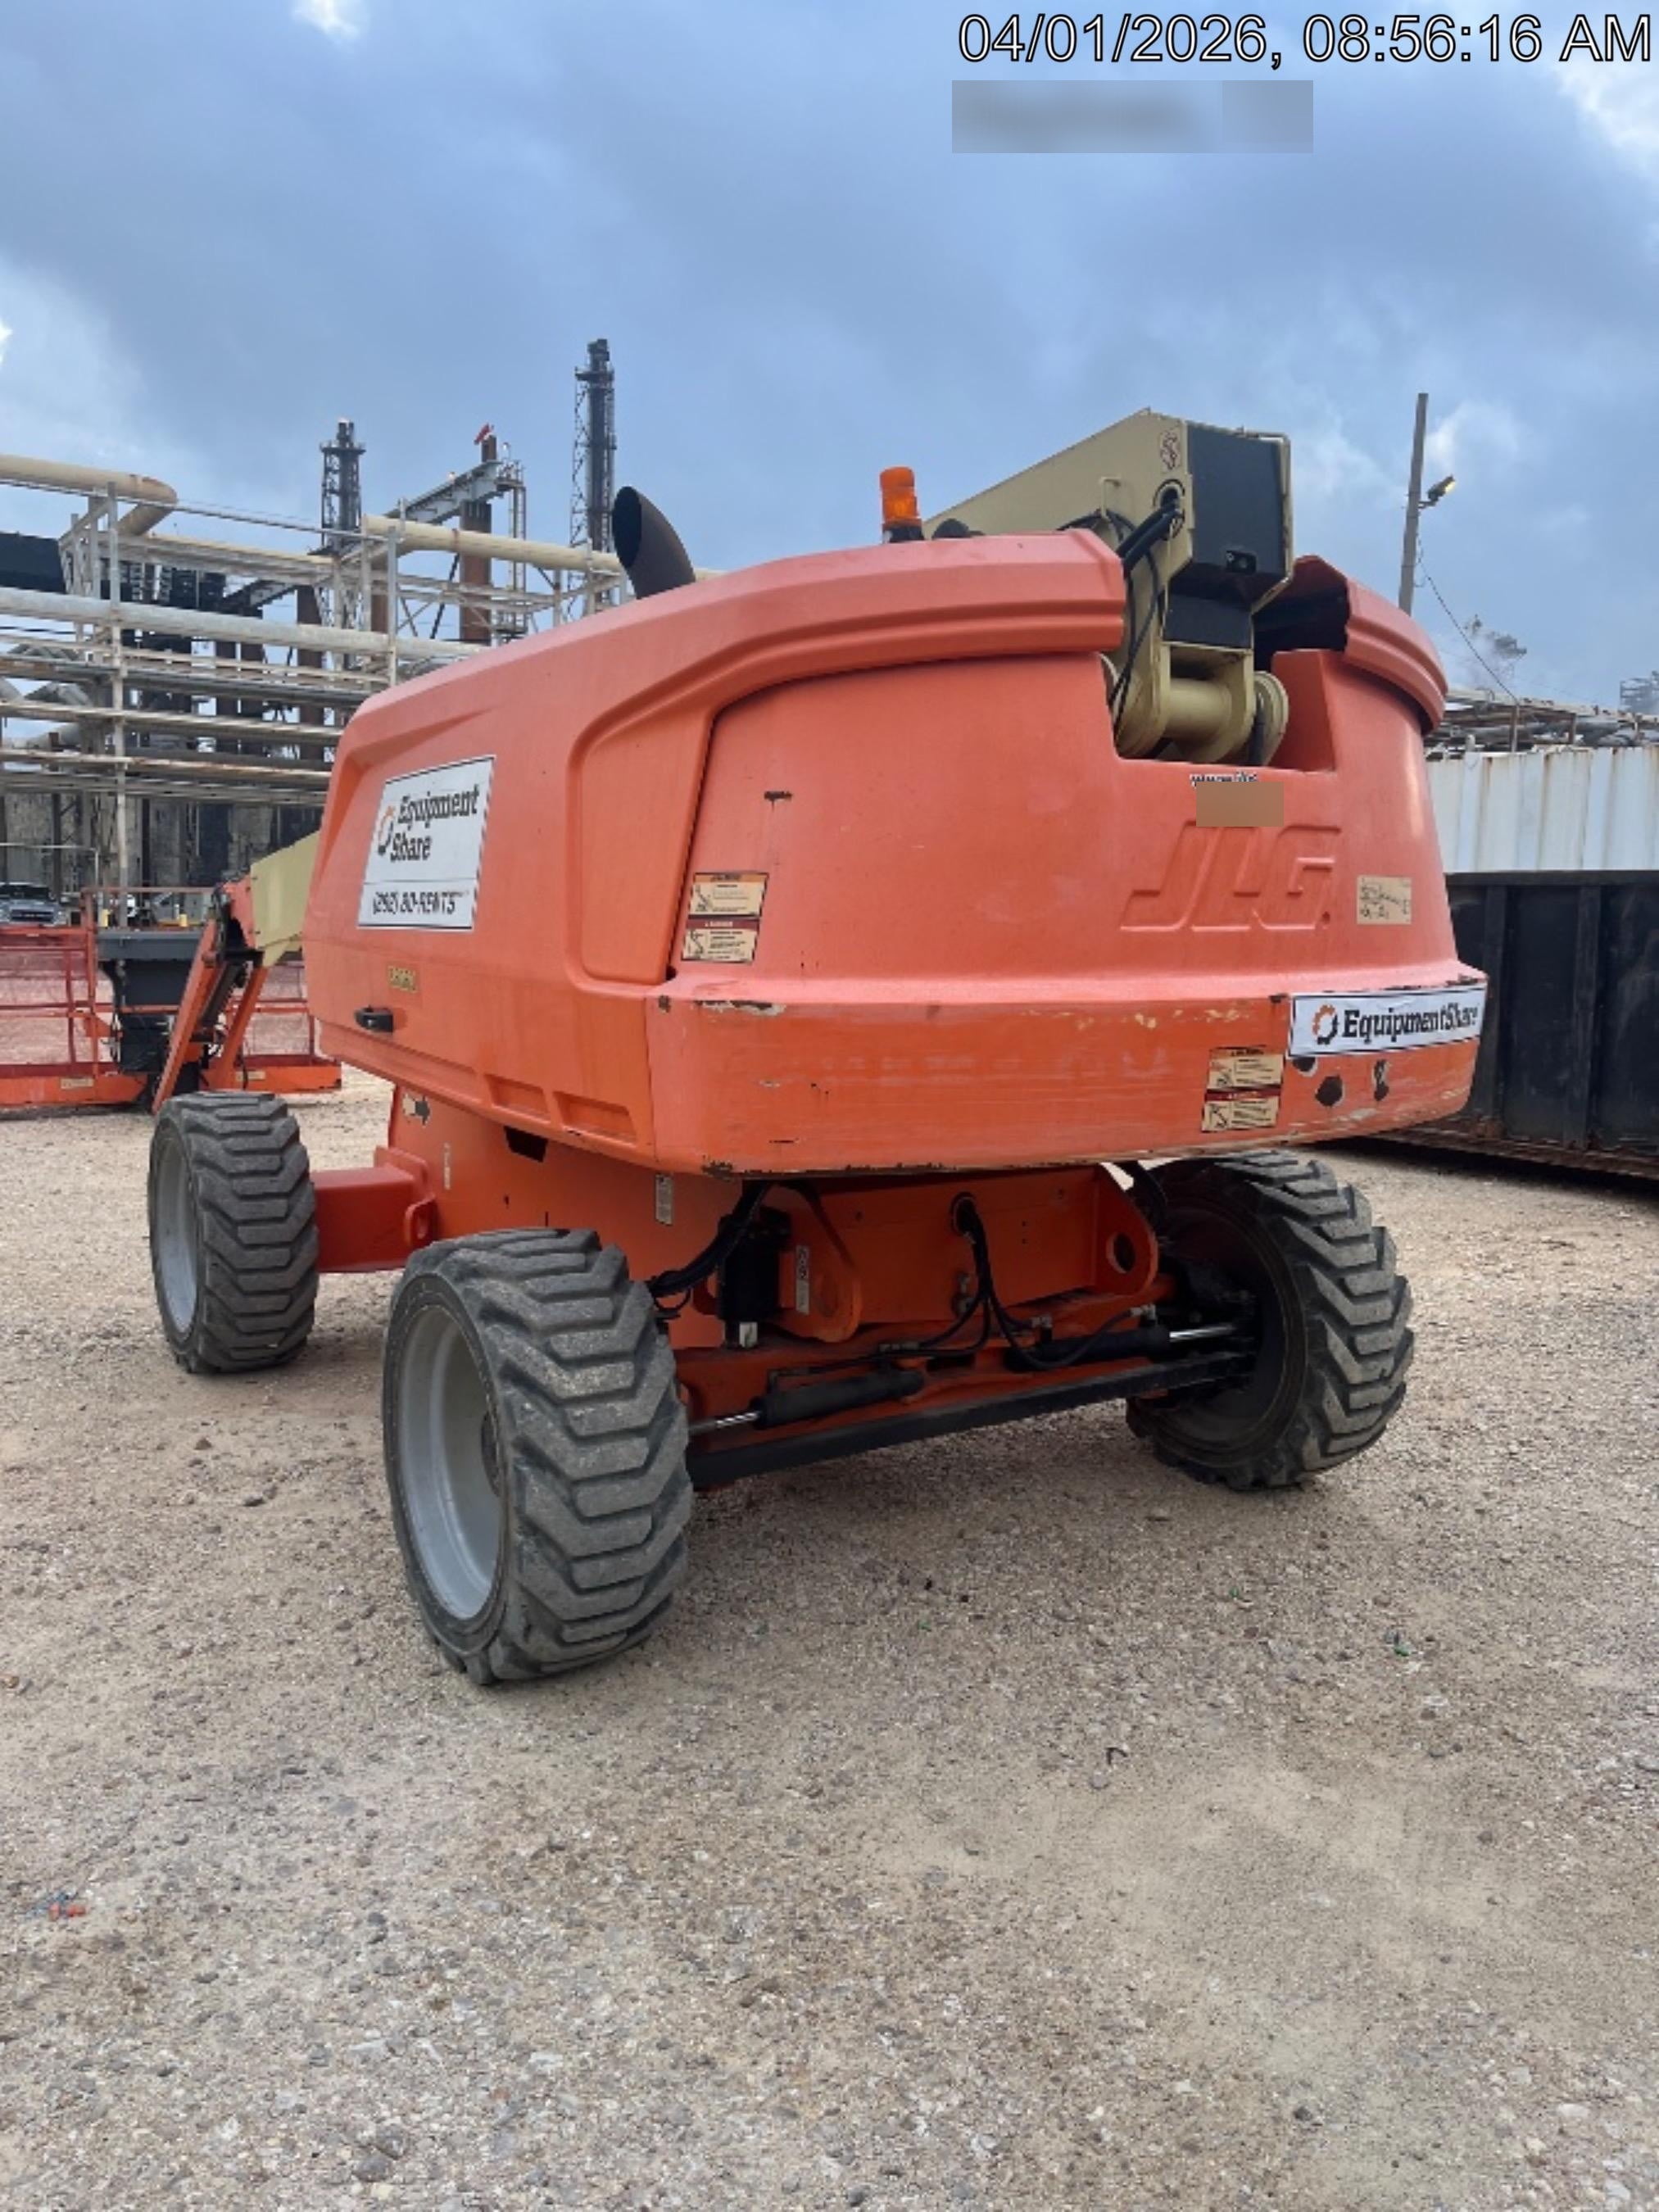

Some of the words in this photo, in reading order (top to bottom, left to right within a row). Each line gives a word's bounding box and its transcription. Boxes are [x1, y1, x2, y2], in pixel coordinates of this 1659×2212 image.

[397, 784, 479, 831] Equipment
[390, 832, 432, 863] Share
[1121, 819, 1341, 931] JLG
